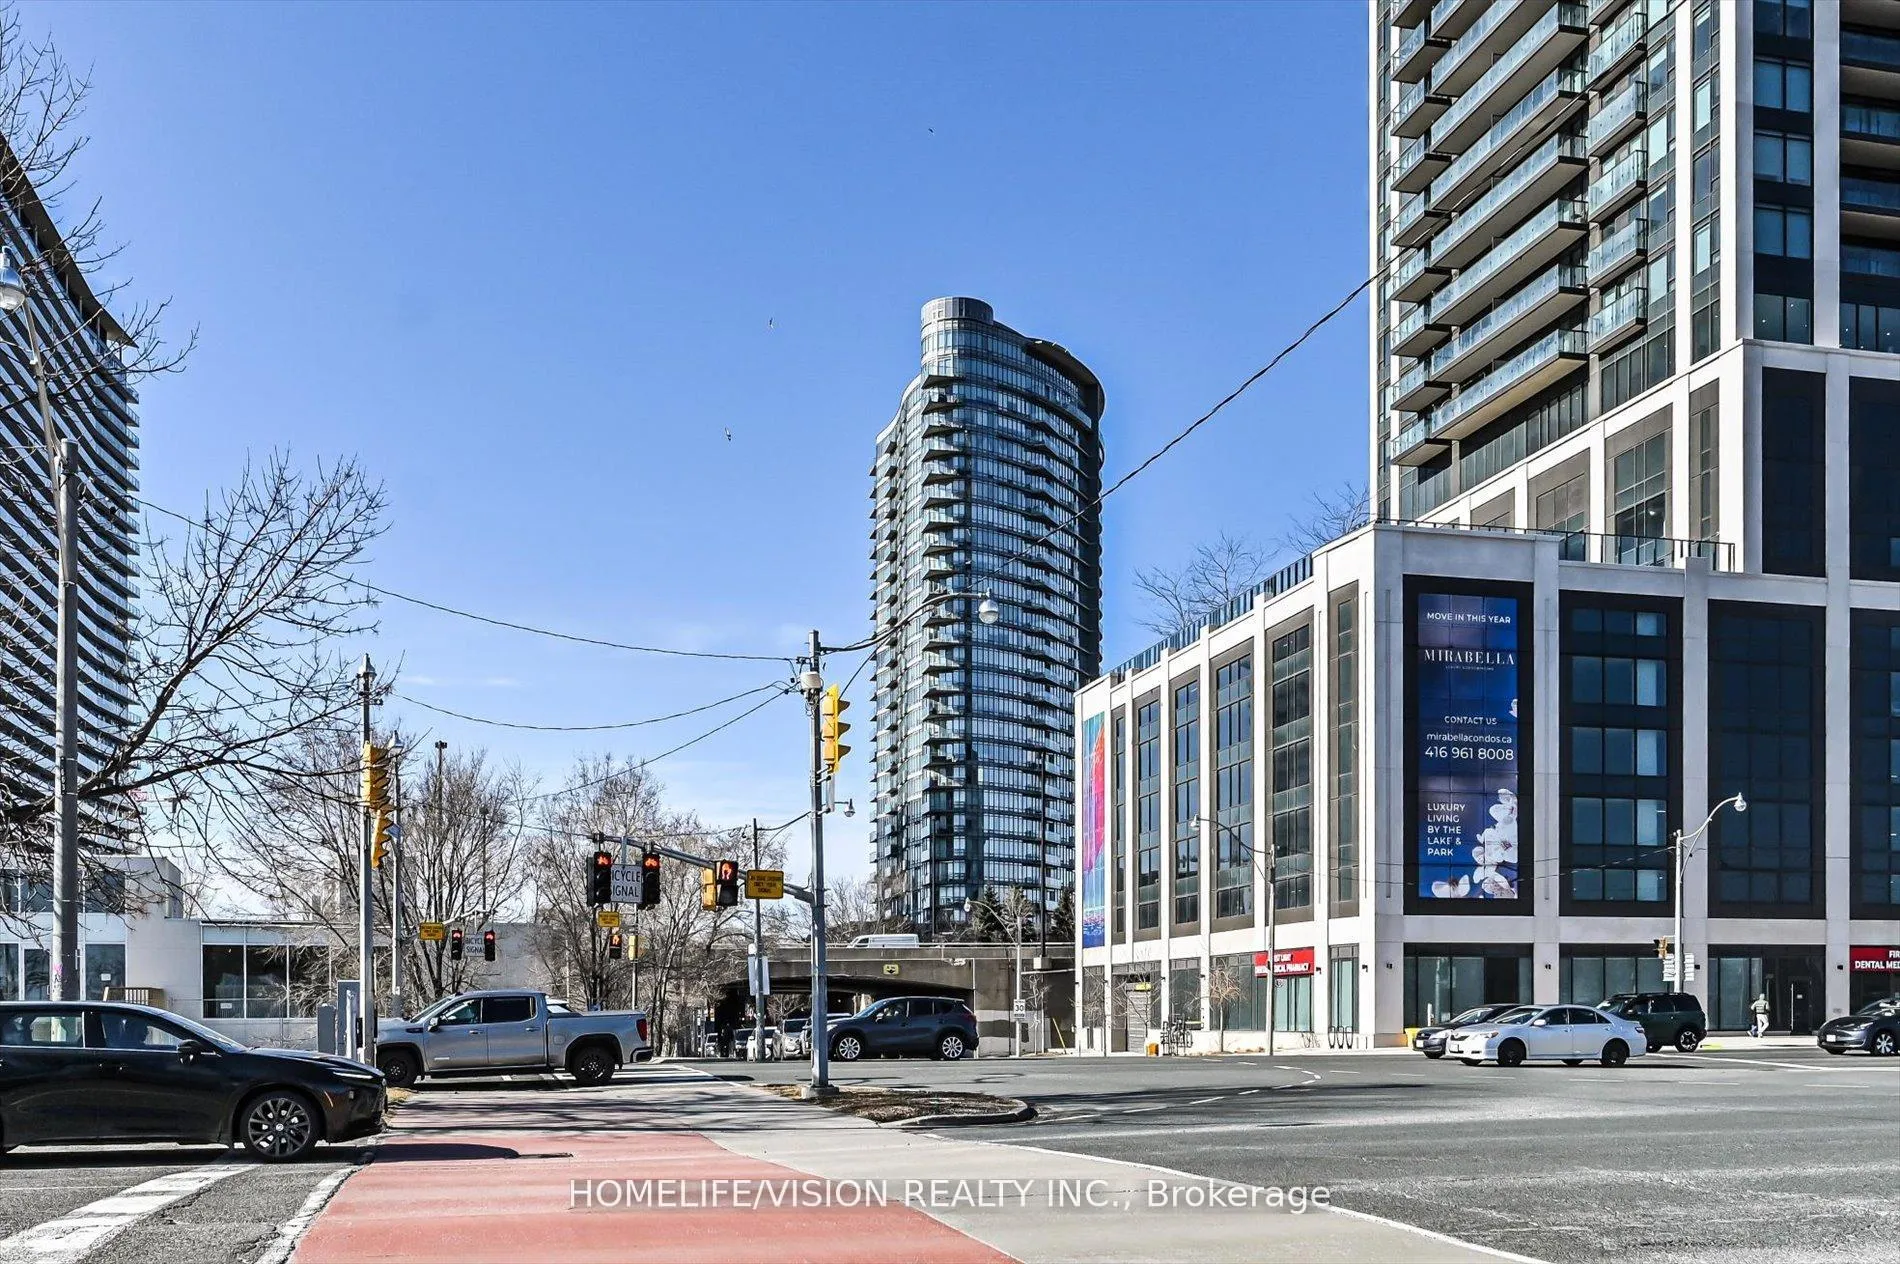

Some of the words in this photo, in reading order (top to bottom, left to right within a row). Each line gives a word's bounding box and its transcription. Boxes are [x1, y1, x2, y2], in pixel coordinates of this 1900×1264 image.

[1427, 612, 1452, 621] MOVE
[1455, 613, 1464, 621] IN
[1467, 614, 1486, 623] THIS
[1488, 615, 1511, 624] YEAR
[1424, 649, 1514, 665] MIRABELLA
[1444, 715, 1483, 724] CONTACT
[1486, 717, 1498, 725] US
[1426, 732, 1512, 744] mirabellacondos.ca
[1425, 746, 1448, 758] 416
[1451, 747, 1473, 759] 961
[1478, 748, 1514, 760] 8008
[1427, 803, 1466, 812] LUXURY
[1427, 814, 1460, 823] LIVING
[1427, 825, 1440, 834] BY
[1443, 825, 1462, 834] THE
[1427, 836, 1453, 845] LAKE
[1455, 837, 1462, 845] &
[1427, 848, 1454, 857] PARK
[611, 869, 641, 883] ICYCLE
[612, 885, 639, 898] IGNAL
[1854, 960, 1884, 969] DENTAL
[1015, 1004, 1025, 1012] 30
